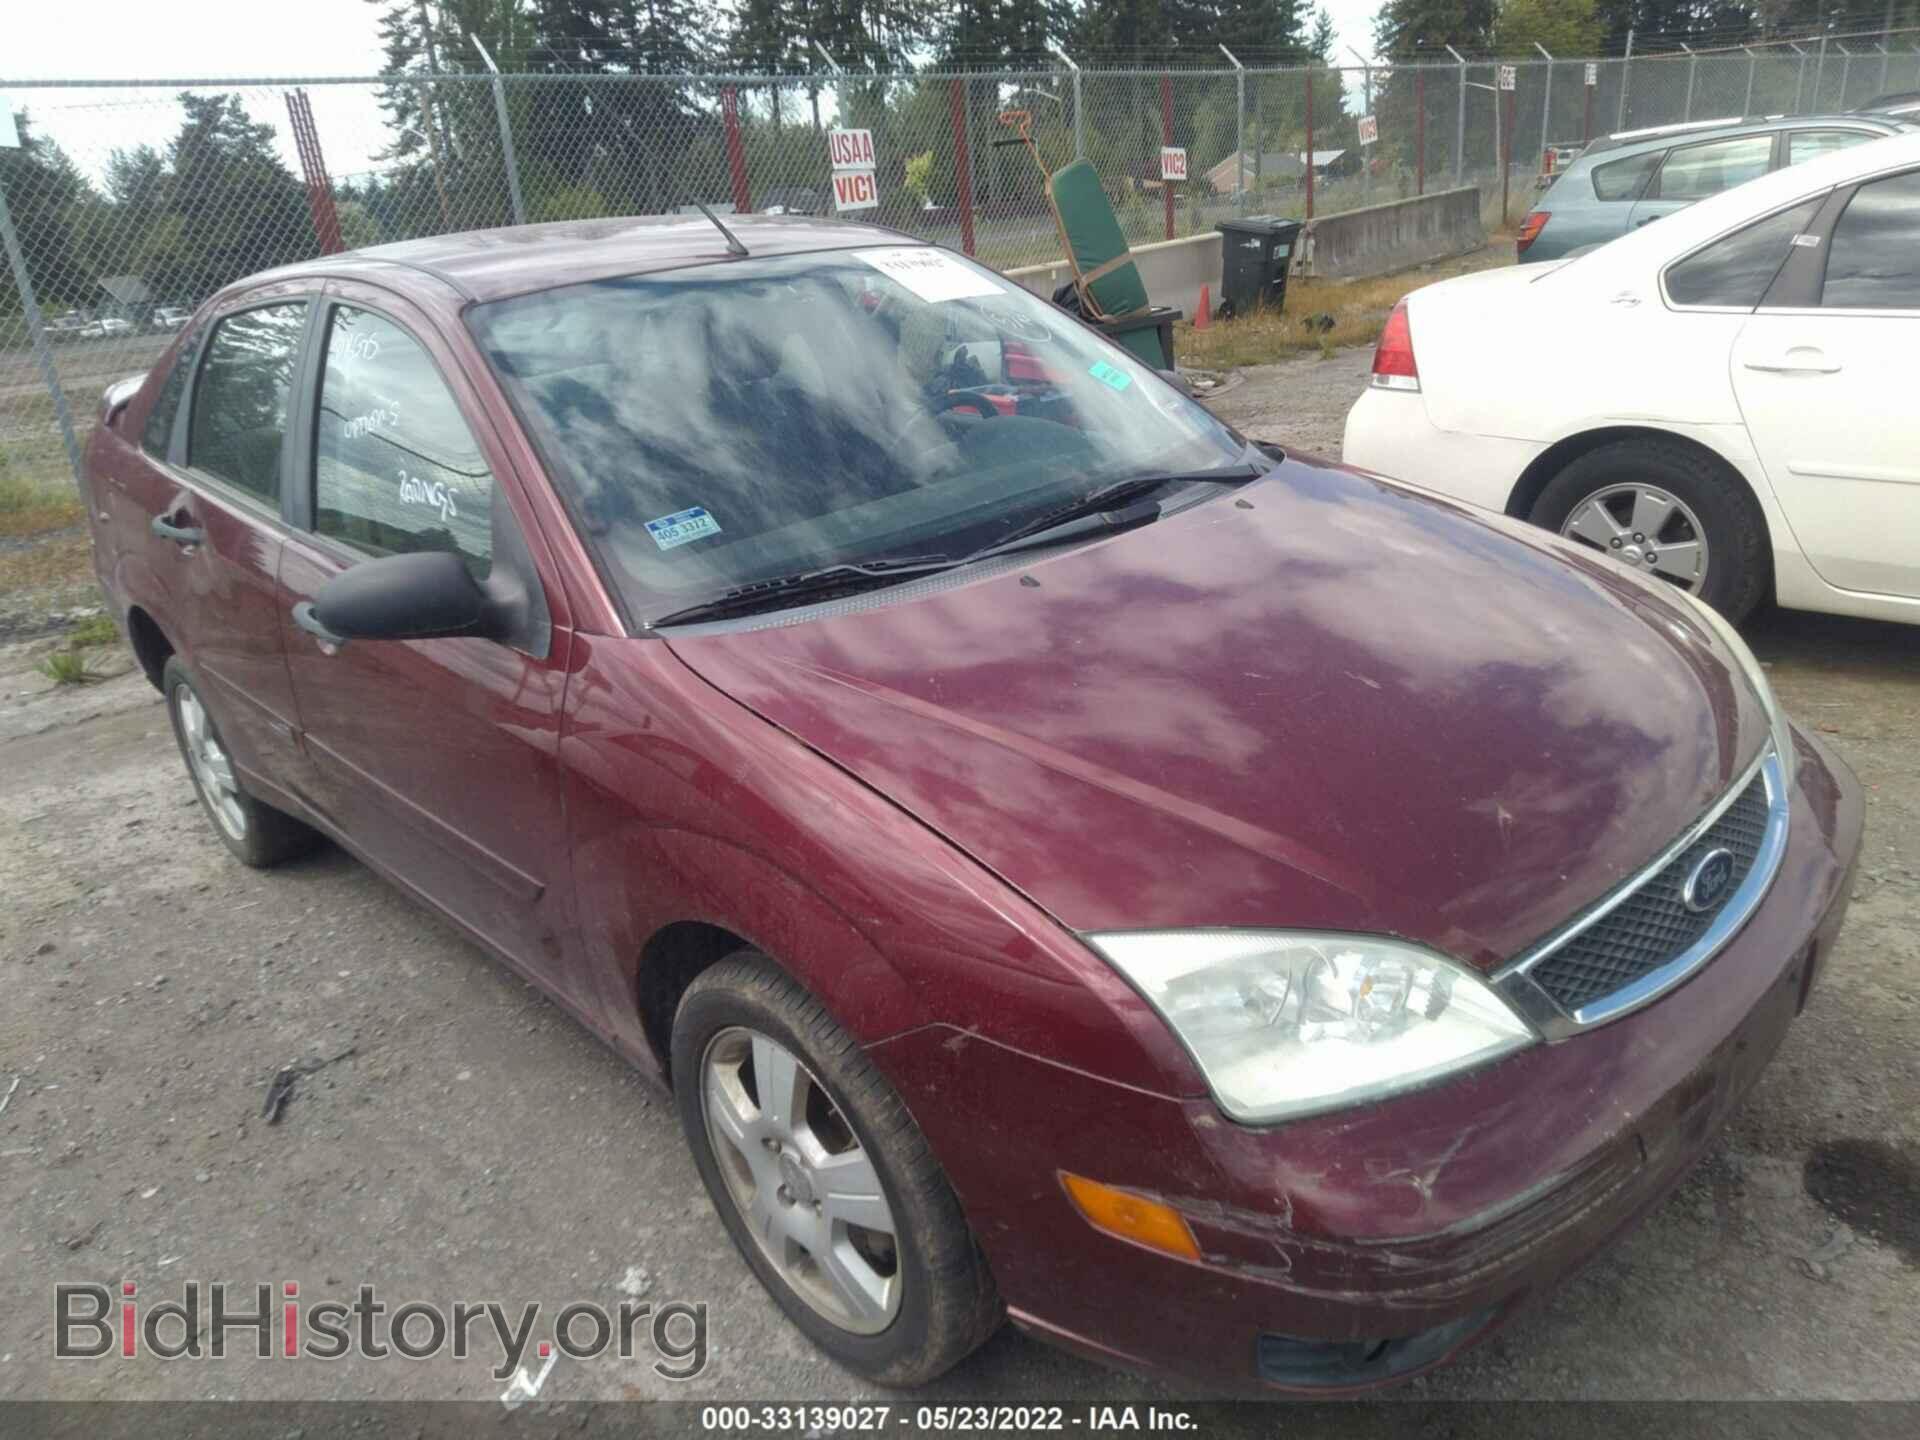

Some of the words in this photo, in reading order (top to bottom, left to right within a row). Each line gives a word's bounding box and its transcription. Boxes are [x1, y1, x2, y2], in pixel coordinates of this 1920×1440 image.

[831, 131, 874, 164] USAA
[1162, 152, 1185, 175] VIC2
[835, 174, 875, 204] VIC1
